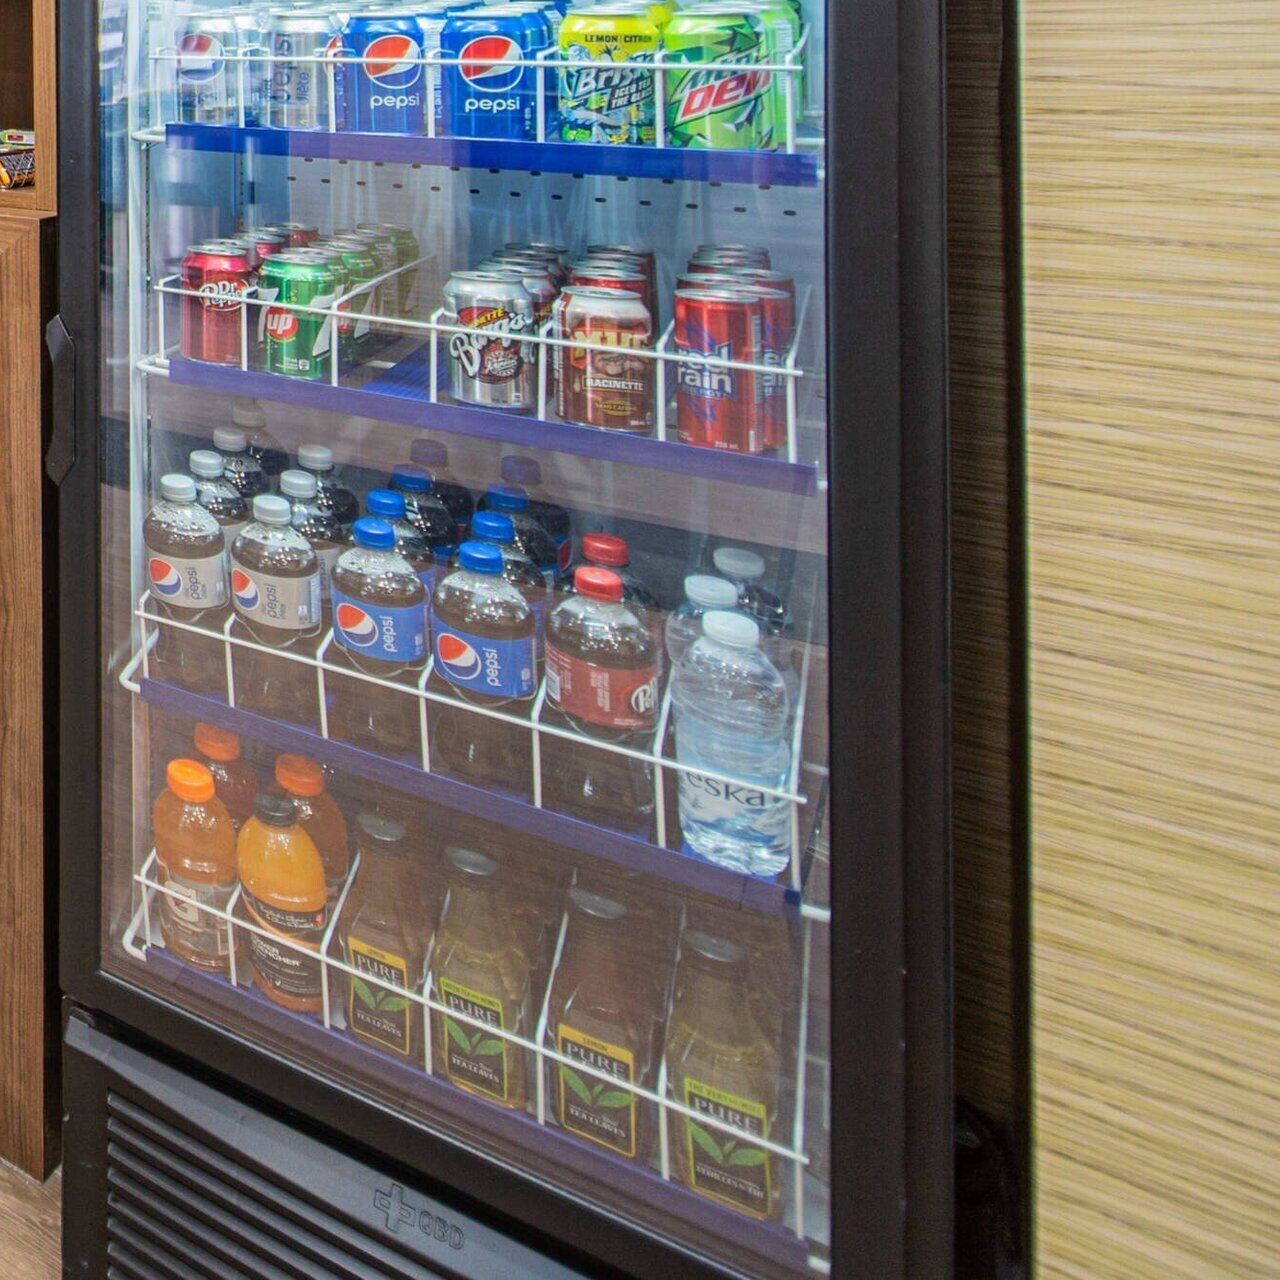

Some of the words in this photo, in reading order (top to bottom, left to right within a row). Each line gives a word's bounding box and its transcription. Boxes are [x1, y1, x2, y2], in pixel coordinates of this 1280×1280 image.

[584, 34, 618, 43] LEMON
[370, 92, 421, 110] pepsi
[464, 95, 521, 115] pepsi
[218, 279, 238, 292] Dr
[266, 311, 294, 333] up
[677, 366, 733, 395] rain
[187, 567, 203, 601] pepsi
[263, 582, 279, 620] pepsi
[379, 614, 398, 653] pepsi
[482, 646, 503, 688] pepsi
[685, 771, 766, 807] eska
[356, 954, 401, 979] PURE
[449, 995, 498, 1023] PURE
[357, 1012, 372, 1024] TEA
[372, 1018, 402, 1038] LEAVES
[452, 1056, 468, 1070] TEA
[468, 1061, 500, 1084] LEAVES
[566, 1042, 627, 1074] PURE
[694, 1097, 758, 1129] PURE
[418, 1210, 464, 1250] QBD
